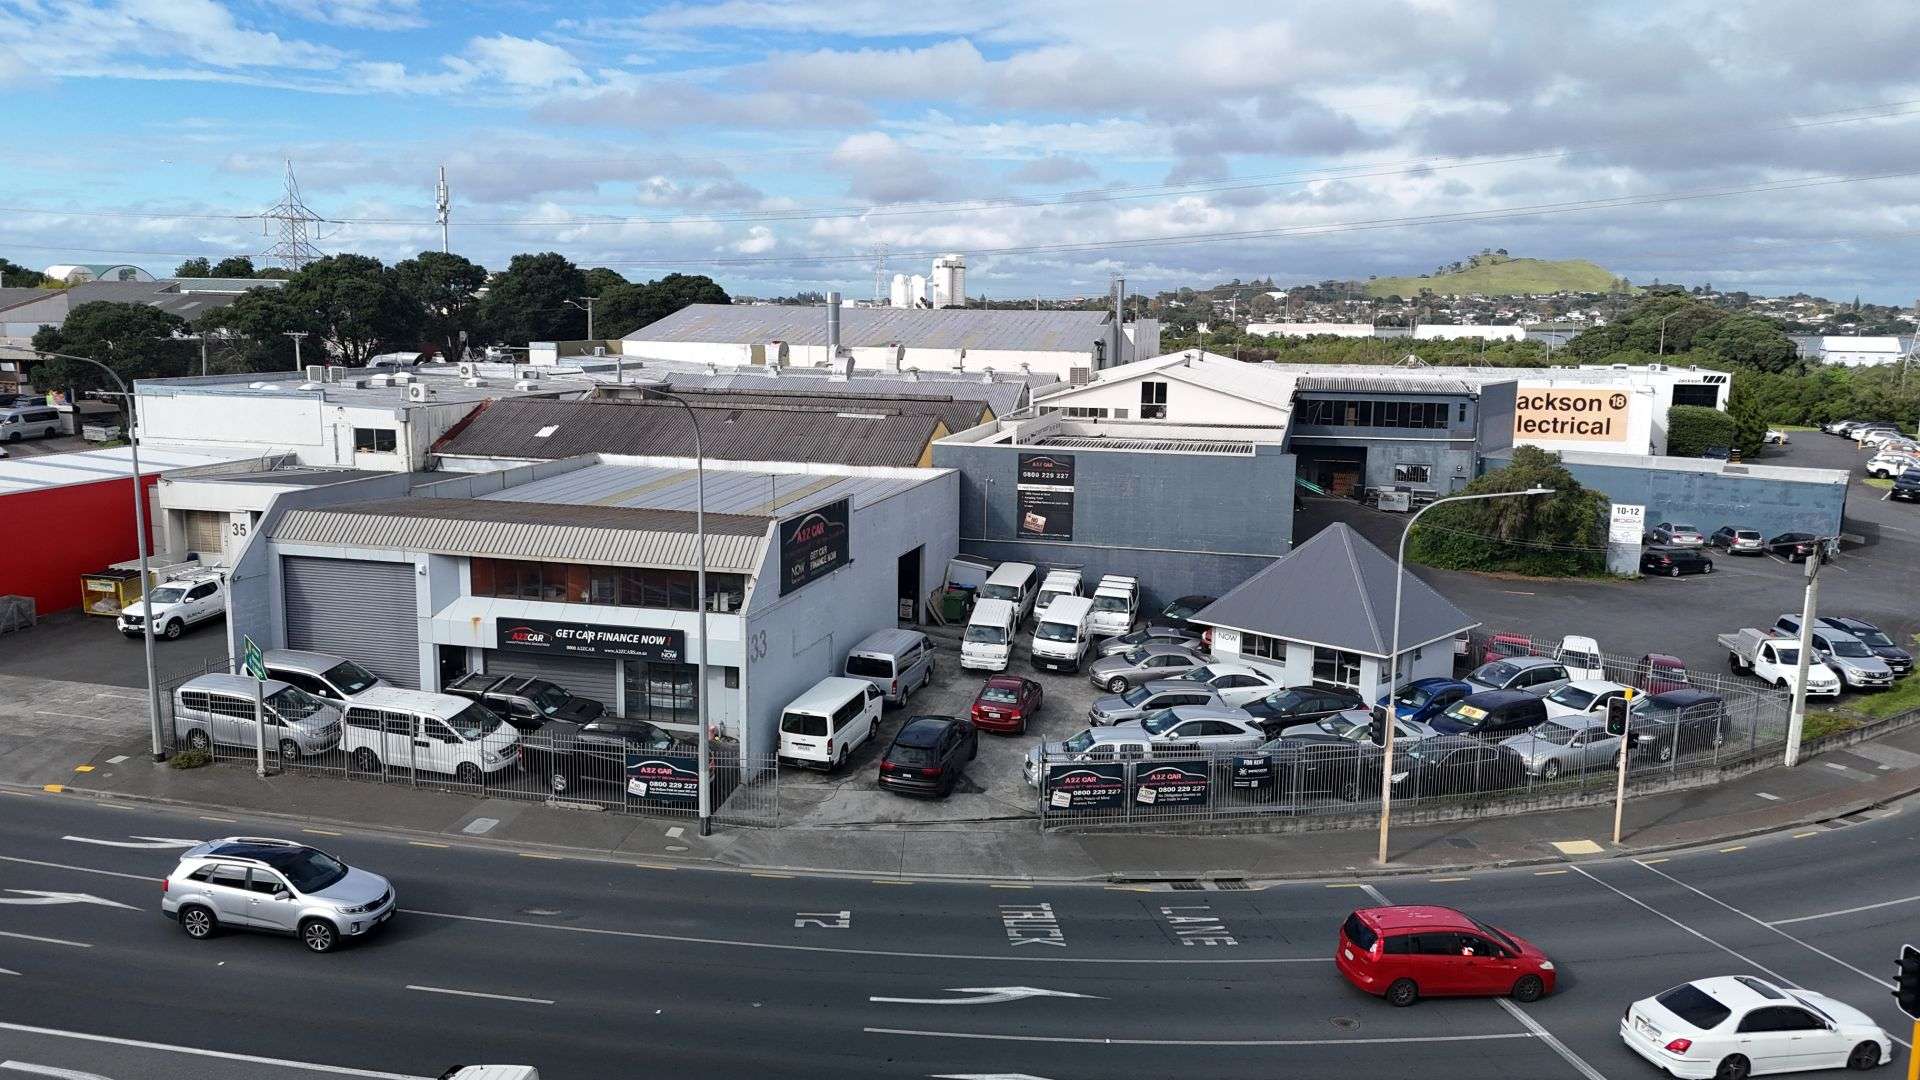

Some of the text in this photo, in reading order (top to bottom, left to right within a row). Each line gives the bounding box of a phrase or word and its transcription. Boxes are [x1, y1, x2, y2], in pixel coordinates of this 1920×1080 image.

[1517, 393, 1626, 412] ackson 18
[1517, 415, 1611, 435] lectrical
[1617, 507, 1640, 516] 10-12
[232, 522, 247, 537] 35
[811, 521, 825, 537] CAR
[555, 629, 575, 638] GET
[576, 630, 596, 641] CAR
[597, 632, 640, 643] FINANCE
[750, 629, 767, 664] 33
[998, 902, 1067, 947] TRUCK
[1159, 905, 1239, 946] LANE
